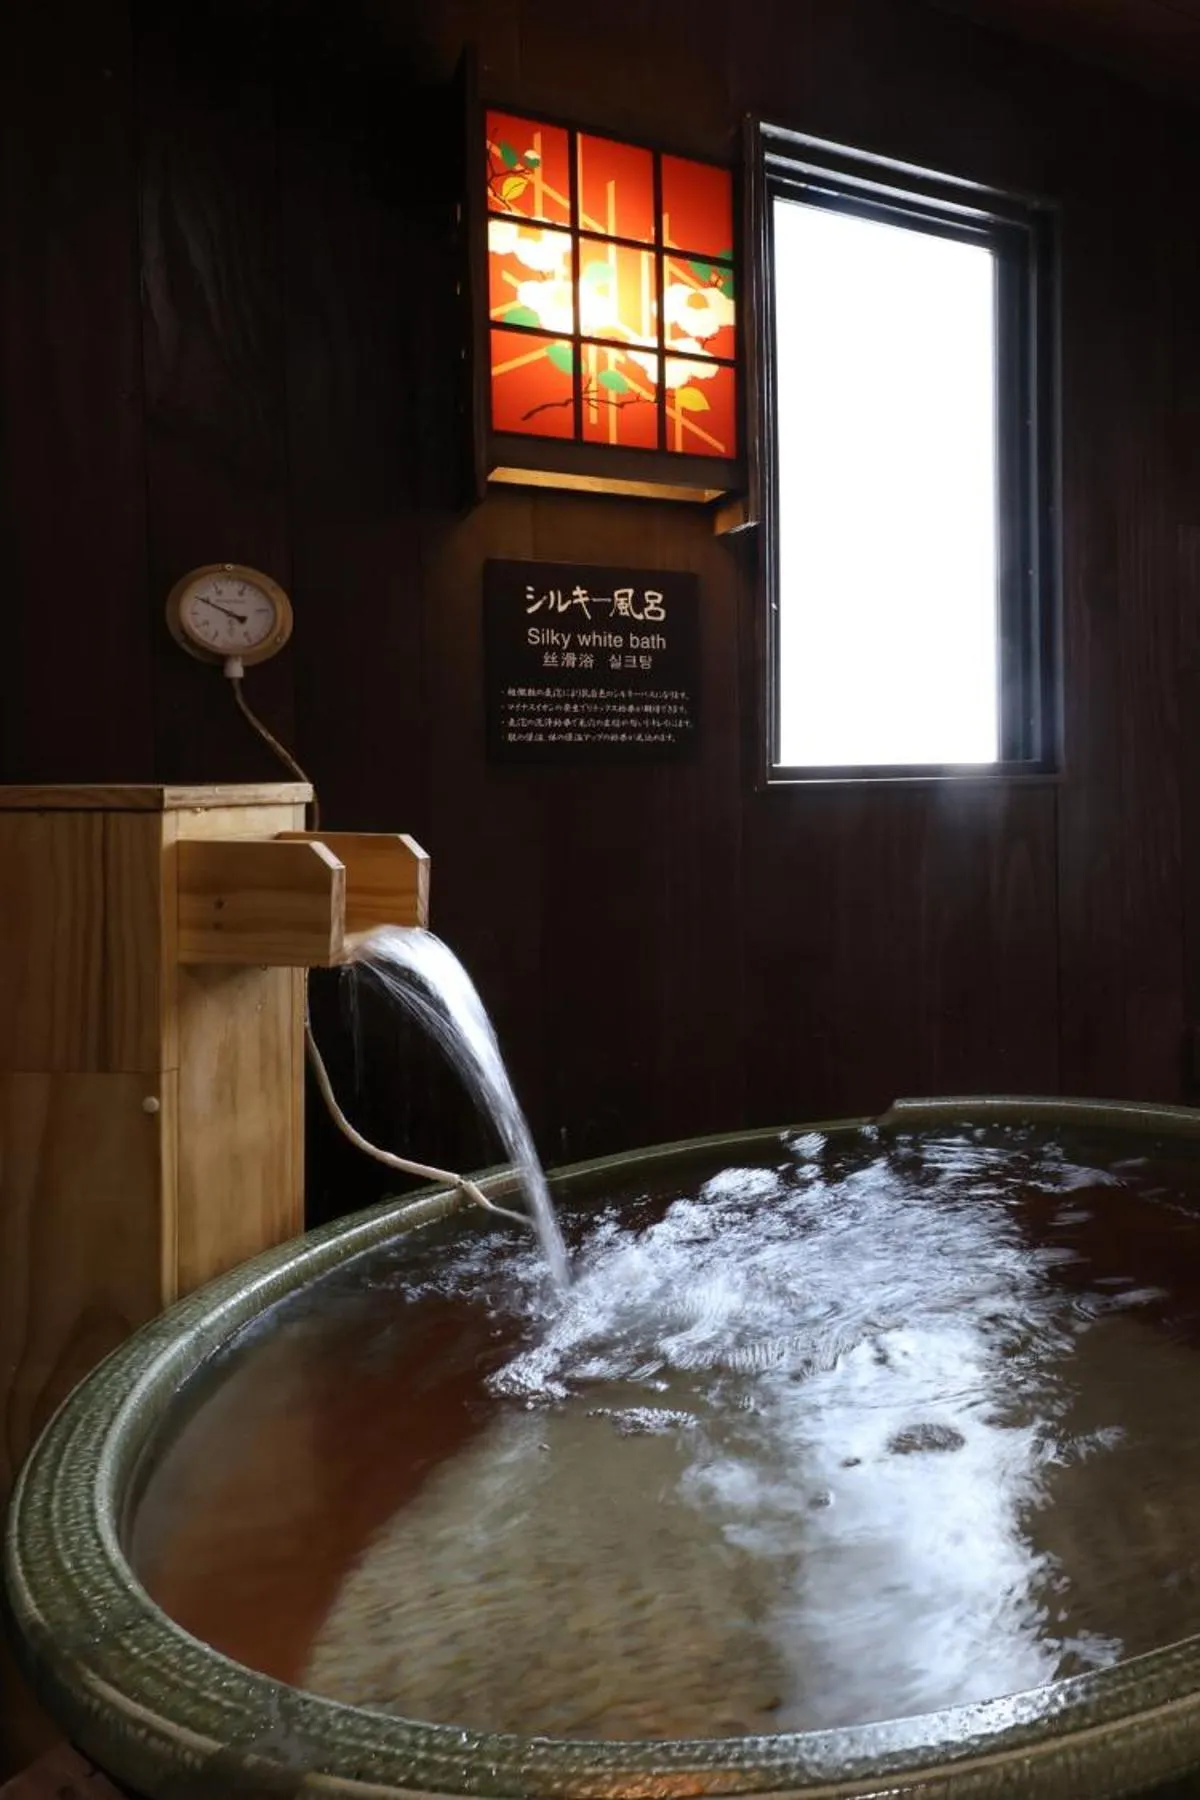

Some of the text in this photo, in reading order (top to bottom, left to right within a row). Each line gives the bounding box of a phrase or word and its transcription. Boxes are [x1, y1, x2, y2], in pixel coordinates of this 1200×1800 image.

[525, 585, 666, 621] シルキー風呂
[527, 627, 666, 650] Silky white bath
[542, 652, 595, 668] 丝滑浴
[608, 654, 653, 670] 실크탕
